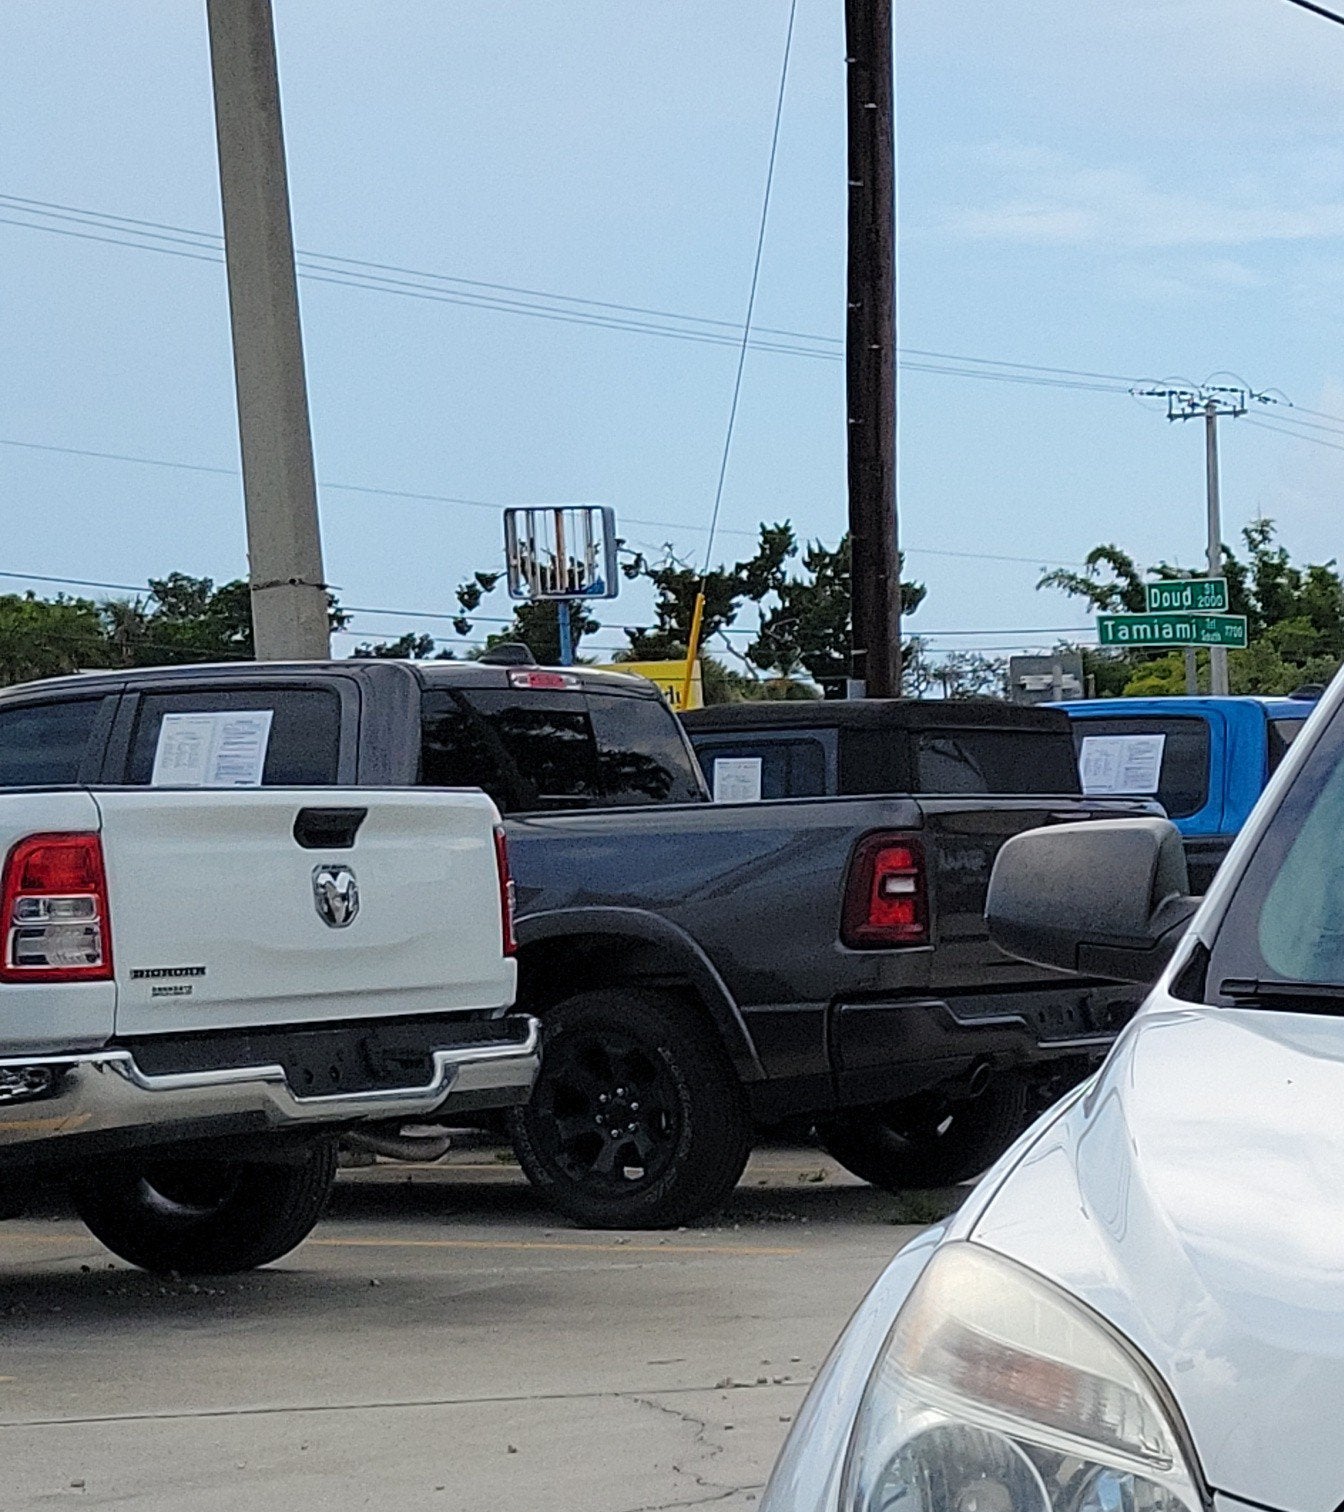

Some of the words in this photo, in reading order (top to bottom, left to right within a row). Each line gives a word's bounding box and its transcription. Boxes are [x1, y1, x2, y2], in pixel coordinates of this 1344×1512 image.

[1150, 586, 1192, 608] Doud
[1197, 595, 1223, 608] 2000
[1103, 619, 1198, 641] Tamiami
